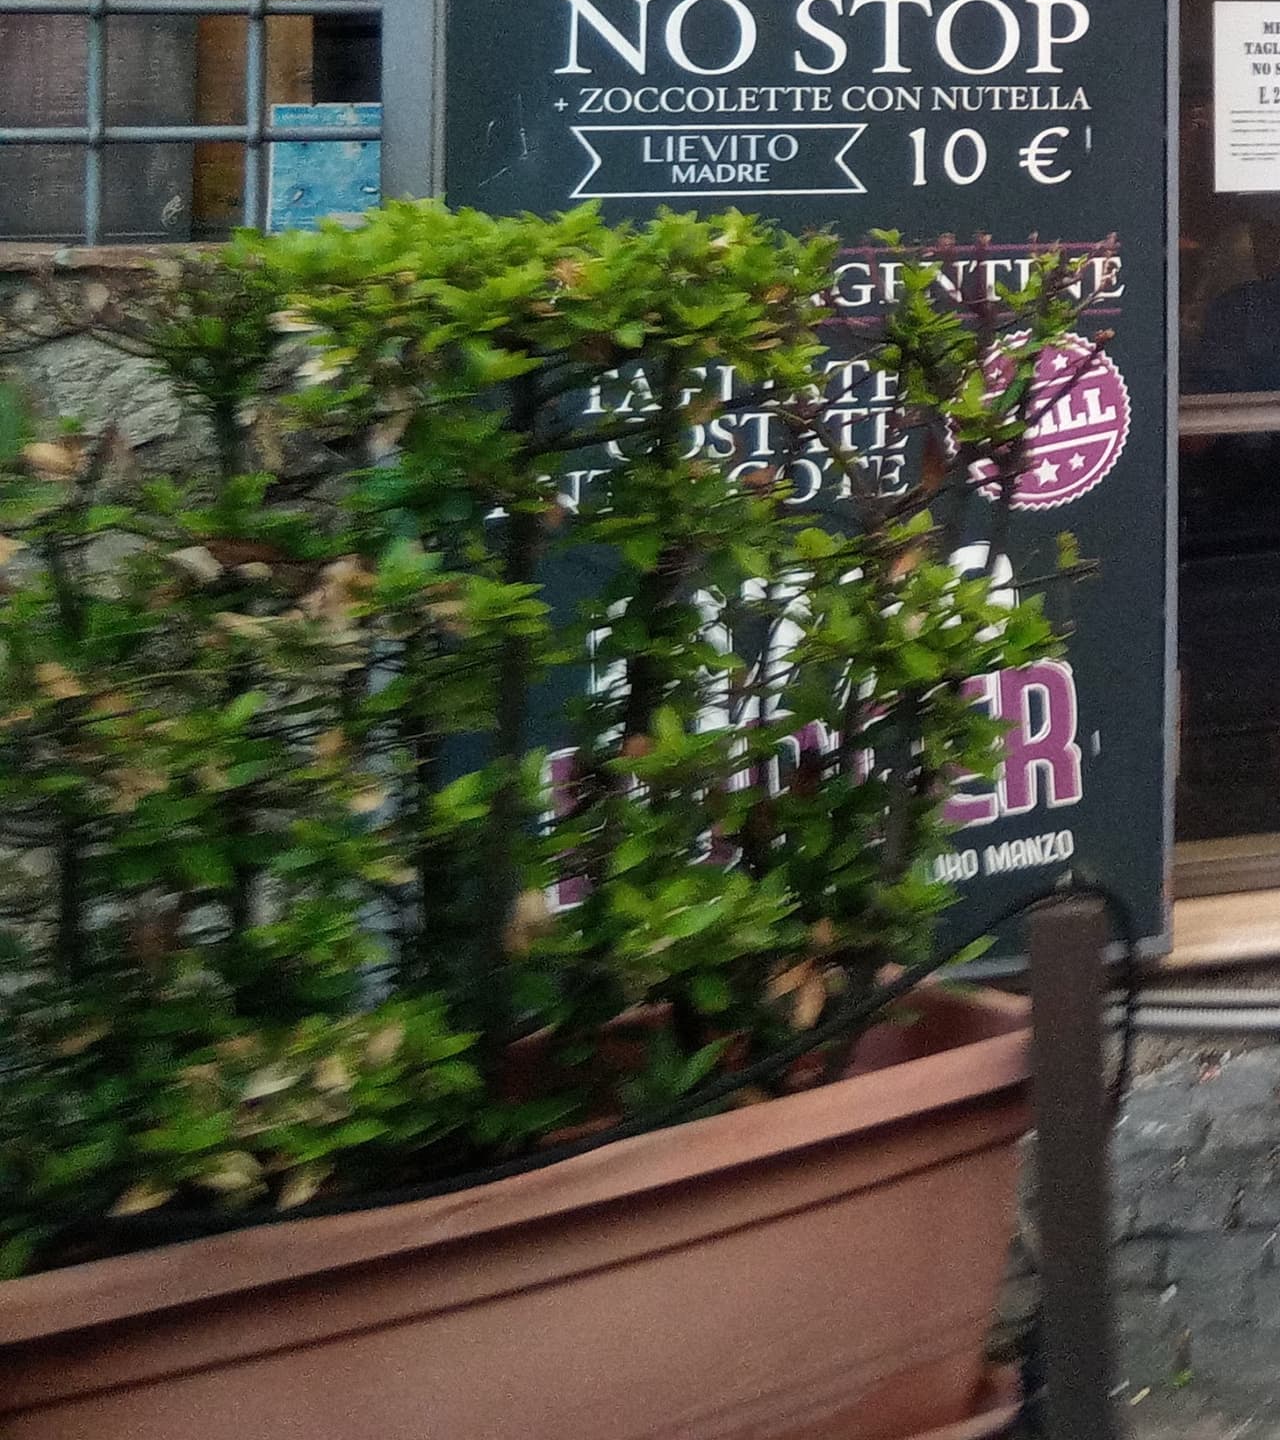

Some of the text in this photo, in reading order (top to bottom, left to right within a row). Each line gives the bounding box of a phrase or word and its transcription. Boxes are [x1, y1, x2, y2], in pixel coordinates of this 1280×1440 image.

[1252, 63, 1271, 75] NO
[578, 86, 832, 114] ZOCCOLETTE
[842, 86, 920, 112] CON
[933, 85, 1091, 111] NUTELLA
[643, 132, 799, 162] LIEVITO
[908, 125, 1072, 186] 10 €
[671, 162, 770, 184] MADRE
[984, 829, 1075, 876] MANZO
